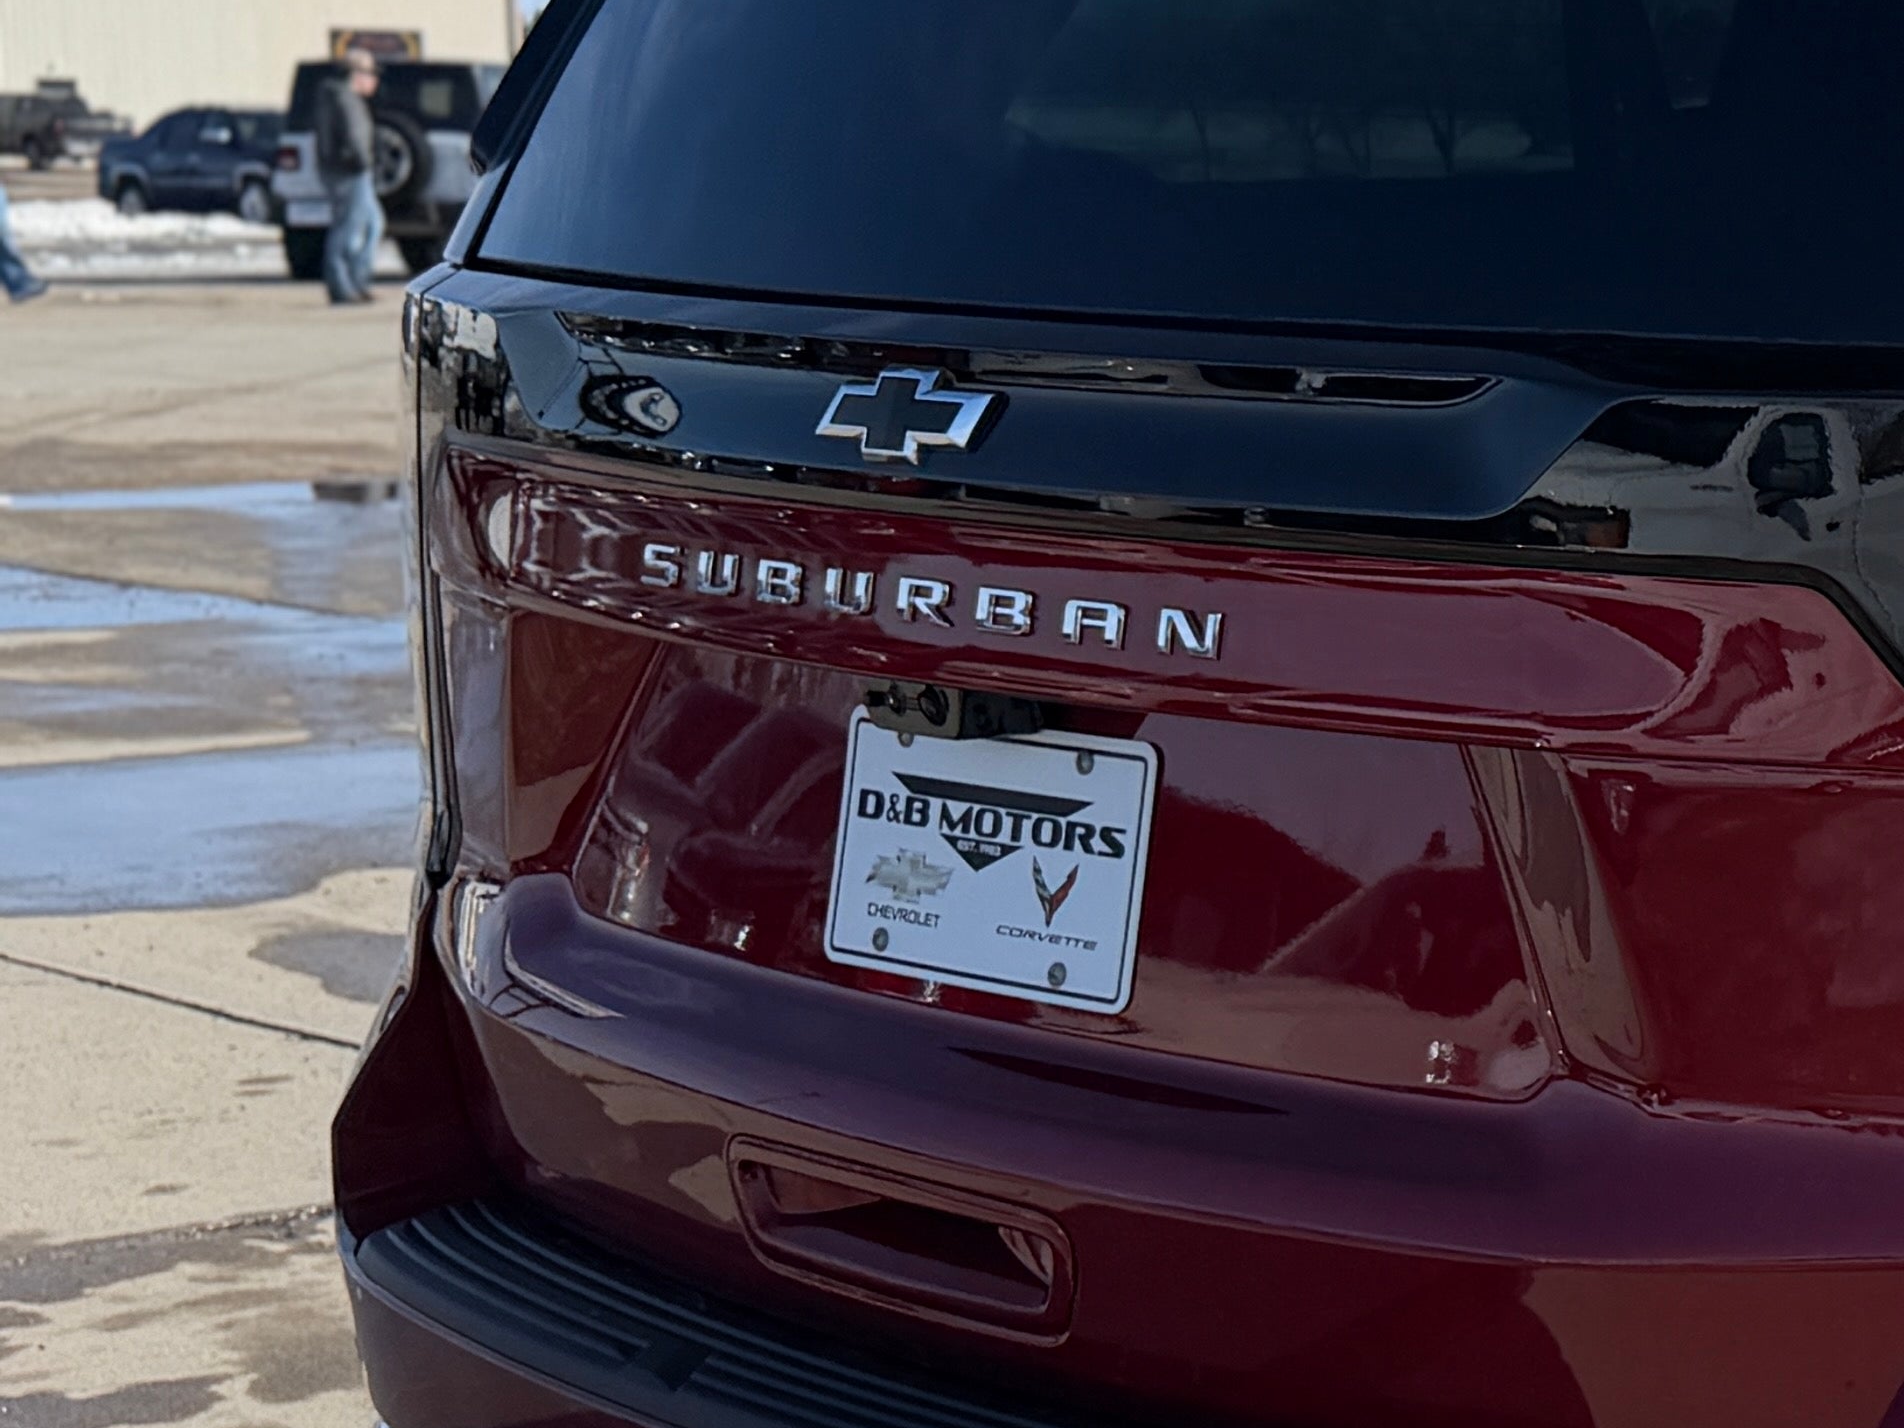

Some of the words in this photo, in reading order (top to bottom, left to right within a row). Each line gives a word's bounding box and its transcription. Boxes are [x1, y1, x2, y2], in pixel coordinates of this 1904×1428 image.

[640, 543, 1225, 660] SUBURBAN
[857, 789, 931, 828] D&B
[939, 802, 1127, 859] MOTORS
[867, 903, 940, 929] CHEVROLET
[996, 925, 1098, 951] CORVETTE
